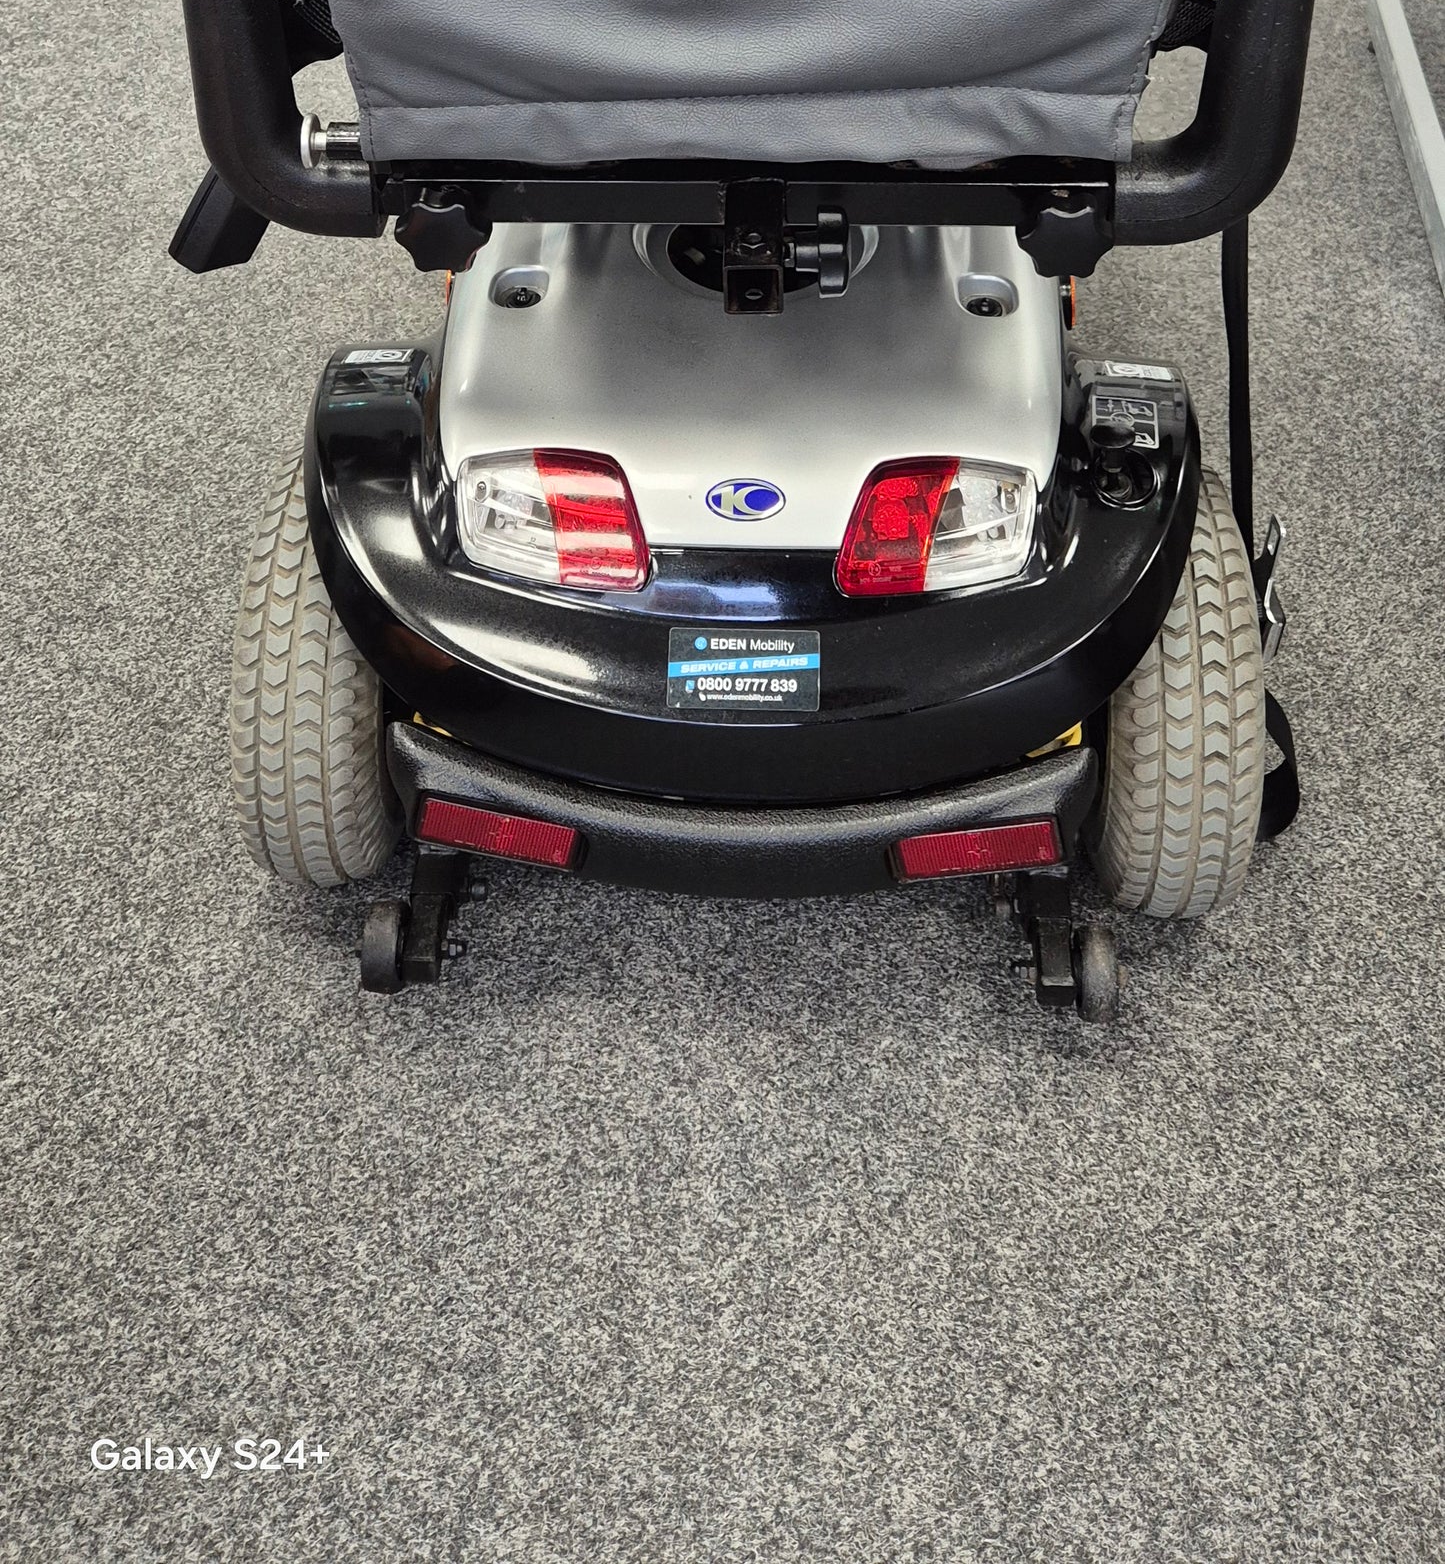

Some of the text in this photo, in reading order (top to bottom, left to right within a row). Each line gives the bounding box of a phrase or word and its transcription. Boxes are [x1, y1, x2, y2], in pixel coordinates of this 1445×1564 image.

[710, 638, 795, 654] EDEN Mobility
[680, 656, 809, 674] SERVICE & REPAIRS
[697, 677, 798, 693] 0800 9777 839
[706, 693, 783, 703] www.edenmobility.co.uk
